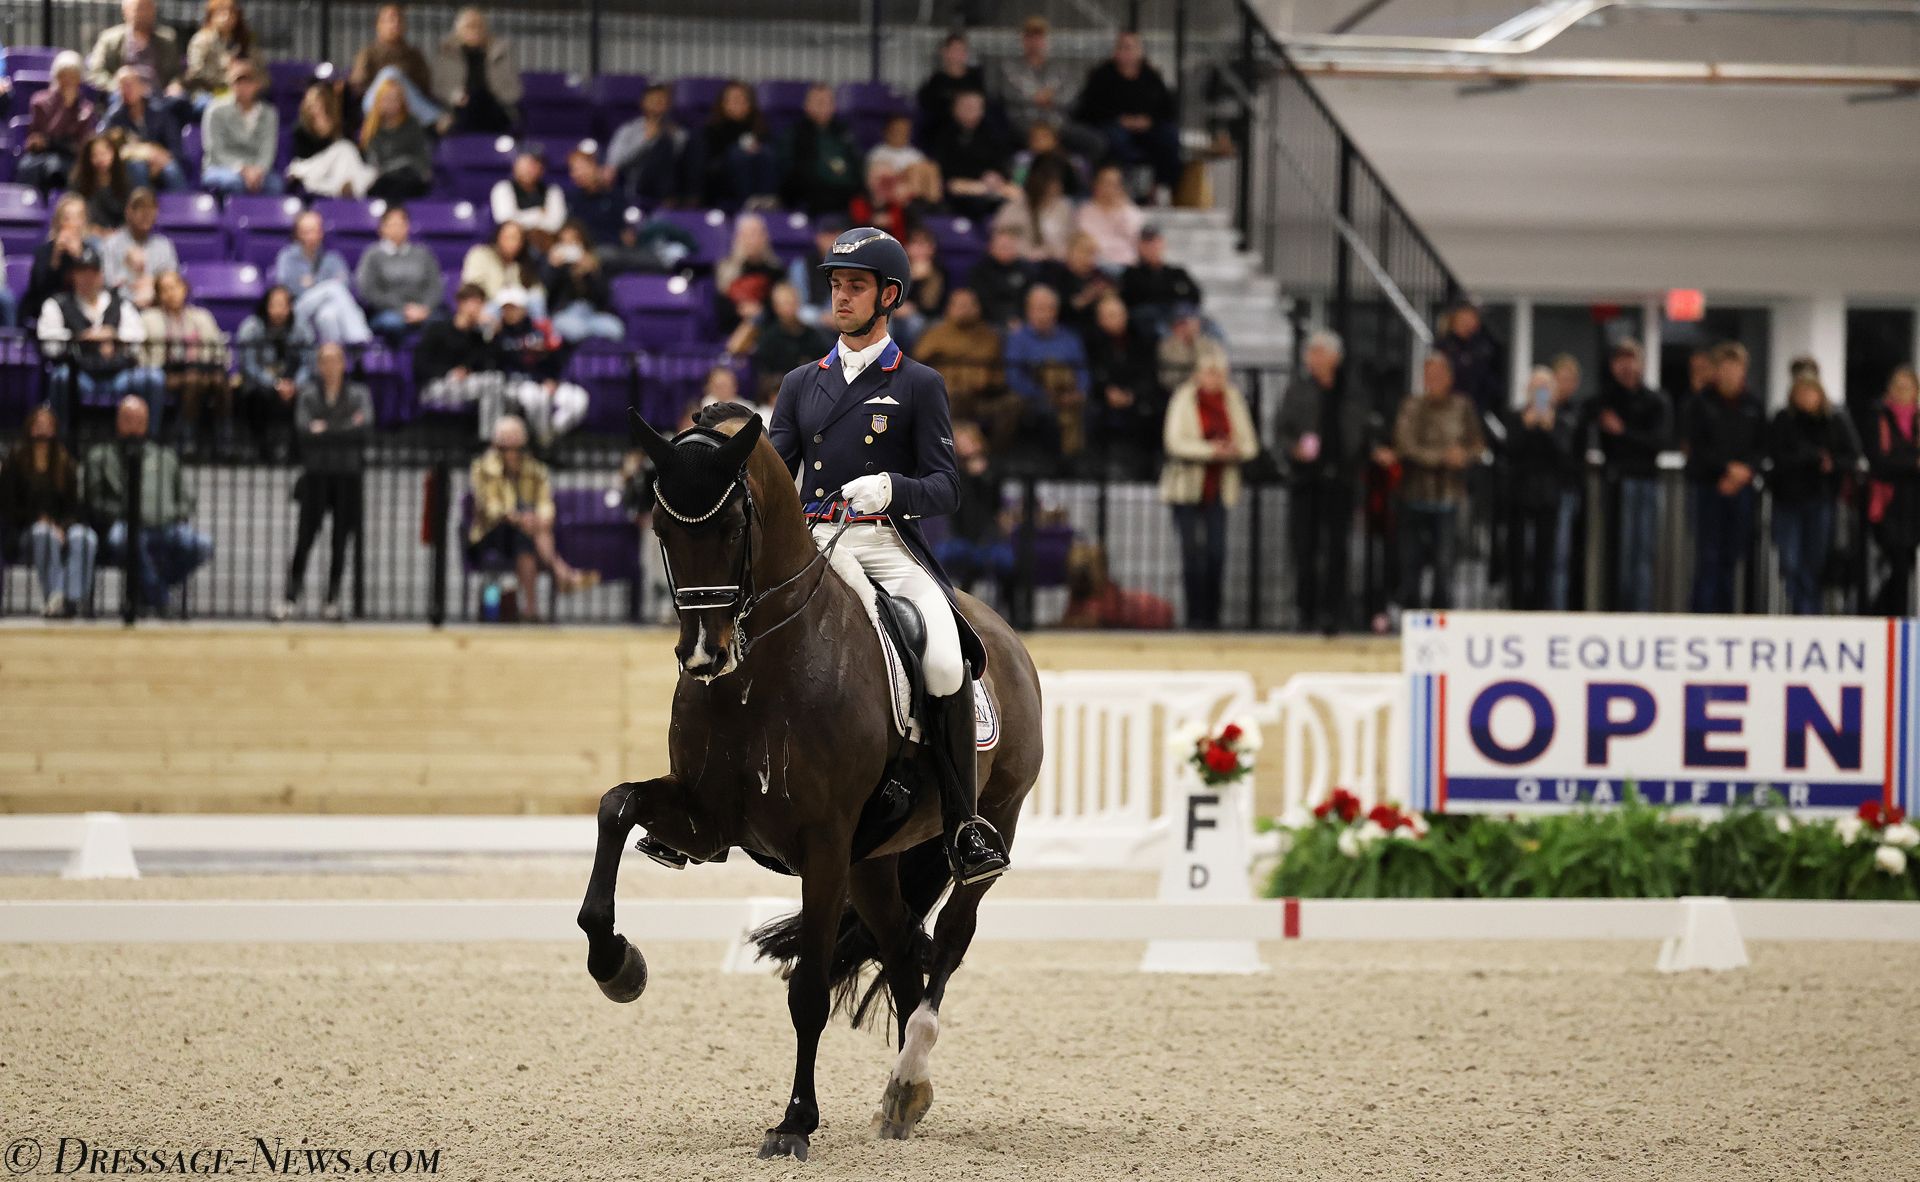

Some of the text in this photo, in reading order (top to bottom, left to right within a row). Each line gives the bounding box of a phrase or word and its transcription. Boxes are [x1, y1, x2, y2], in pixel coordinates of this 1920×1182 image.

[1465, 634, 1866, 672] US EQUESTRIAN
[1468, 679, 1864, 772] OPEN
[1186, 795, 1220, 852] F
[1189, 864, 1210, 890] D
